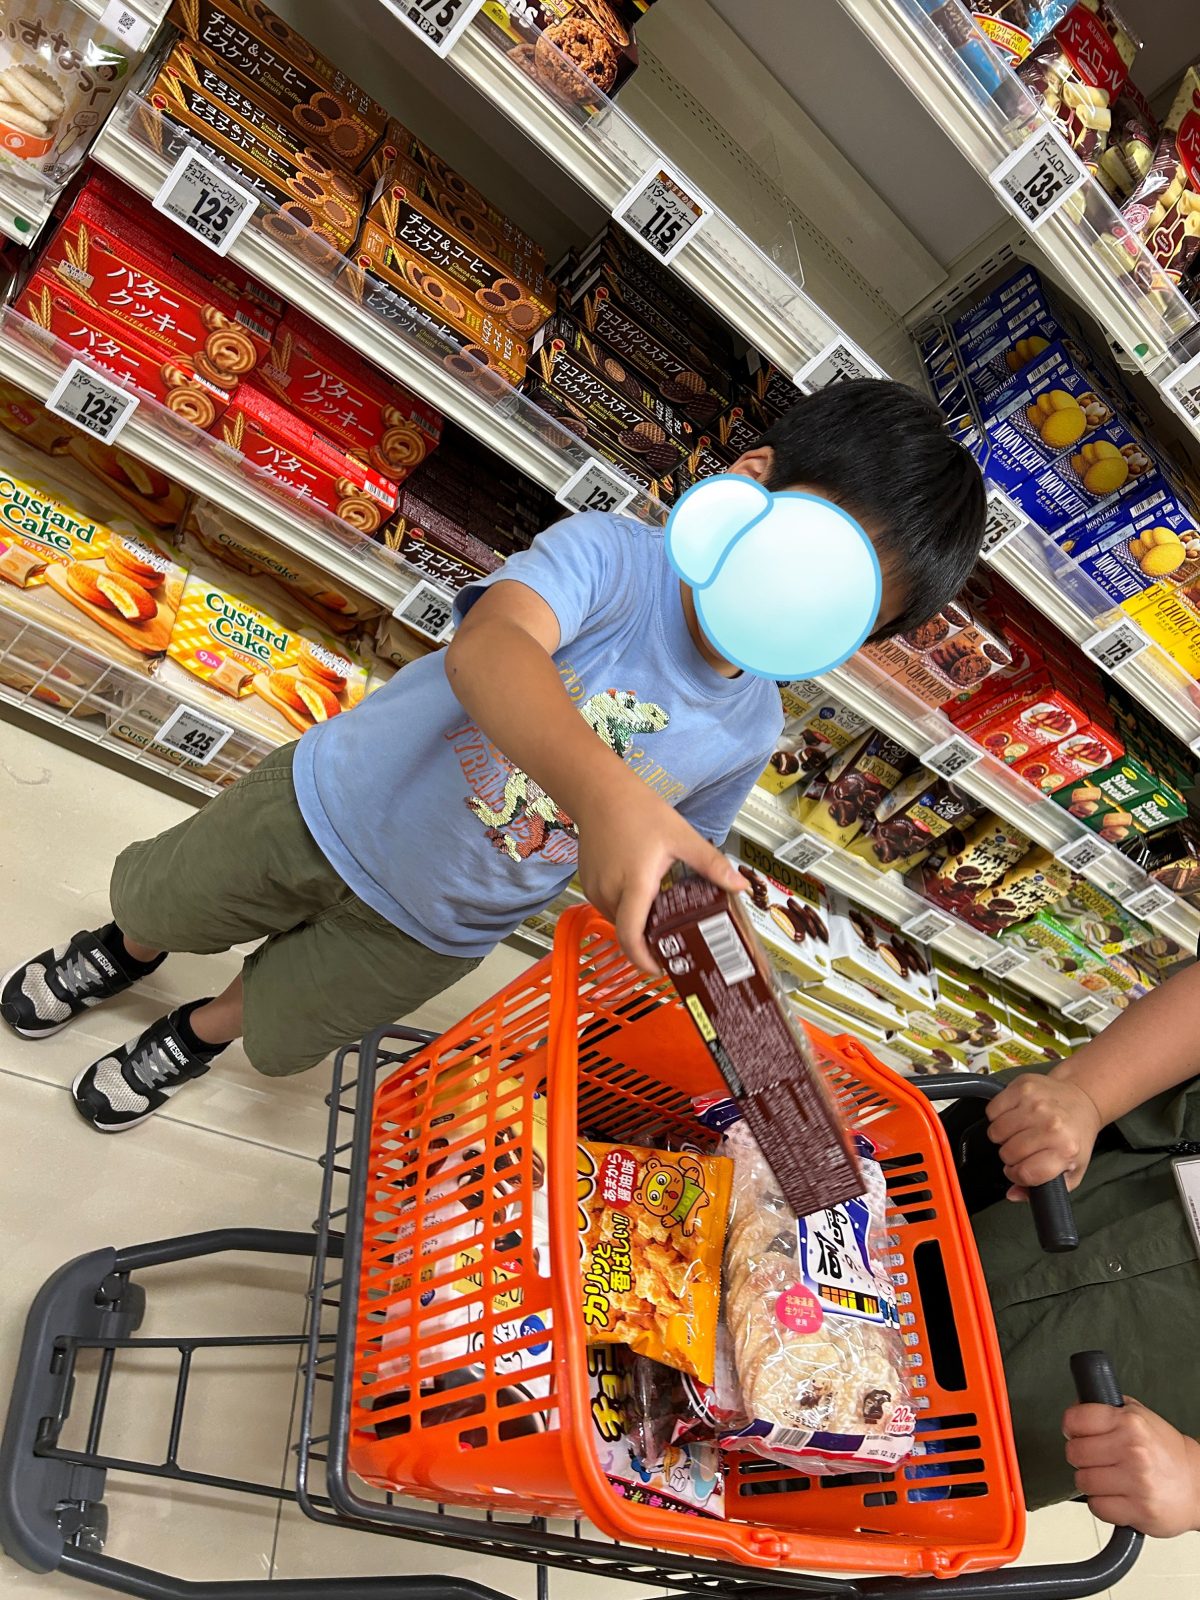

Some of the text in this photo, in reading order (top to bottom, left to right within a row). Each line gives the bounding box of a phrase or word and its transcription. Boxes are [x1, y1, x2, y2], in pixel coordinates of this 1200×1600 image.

[202, 26, 261, 76] ビスケット
[209, 11, 307, 89] チョコ&コーヒー
[1058, 16, 1123, 91] バームロール
[202, 78, 260, 125] ビスケット
[190, 101, 251, 150] ビスケット
[191, 93, 290, 168] チョコ&コーヒー
[1035, 138, 1074, 186] バームロール
[185, 163, 245, 212] チョコ&コーヒービスケット
[648, 183, 693, 226] バタークッキー
[1023, 164, 1063, 206] 135
[192, 188, 235, 231] 125
[646, 204, 683, 244] 115
[399, 225, 451, 267] ビスケット
[406, 212, 492, 277] チョコ&コーヒー
[107, 266, 180, 309] バター
[106, 288, 197, 343] クッキー
[69, 326, 140, 368] バター
[595, 302, 686, 373] チョコダイジェスティブ
[596, 321, 635, 354] ビスケット
[72, 372, 126, 407] バタークッキー
[79, 391, 119, 426] 125
[303, 369, 363, 409] バター
[550, 353, 644, 424] チョコダイジェスティブ
[553, 372, 591, 405] ビスケット
[300, 388, 374, 438] クッキー
[255, 445, 318, 480] バター
[990, 421, 1048, 474] MOONLIGHT
[992, 443, 1022, 474] Cookie
[0, 476, 97, 545] Custard
[584, 485, 618, 512] 125
[988, 500, 1018, 529] ムーンライト
[1035, 469, 1088, 518] MOONLIGHT
[1035, 488, 1064, 518] Cookie
[3, 502, 73, 551] Cake
[984, 515, 1010, 546] 175
[1090, 569, 1118, 597] Cookie
[1092, 552, 1145, 599] MOONLIGHT
[205, 592, 289, 653] Custard
[420, 604, 450, 628] 125
[1154, 611, 1180, 636] Biscuit
[1158, 597, 1191, 637] CHOICE
[215, 617, 271, 661] Cake
[1104, 638, 1132, 663] 175
[183, 728, 216, 752] 425
[941, 752, 966, 772] 165
[1099, 779, 1130, 802] bread
[1111, 772, 1140, 797] Short
[1130, 805, 1160, 829] bread
[1141, 799, 1170, 824] Short
[90, 948, 118, 977] AWESOME
[163, 1036, 190, 1066] AWESOME
[602, 1151, 624, 1203] あまから
[617, 1158, 636, 1202] 醤油味
[582, 1243, 612, 1327] カリッと
[784, 1306, 817, 1320] 生クリーム
